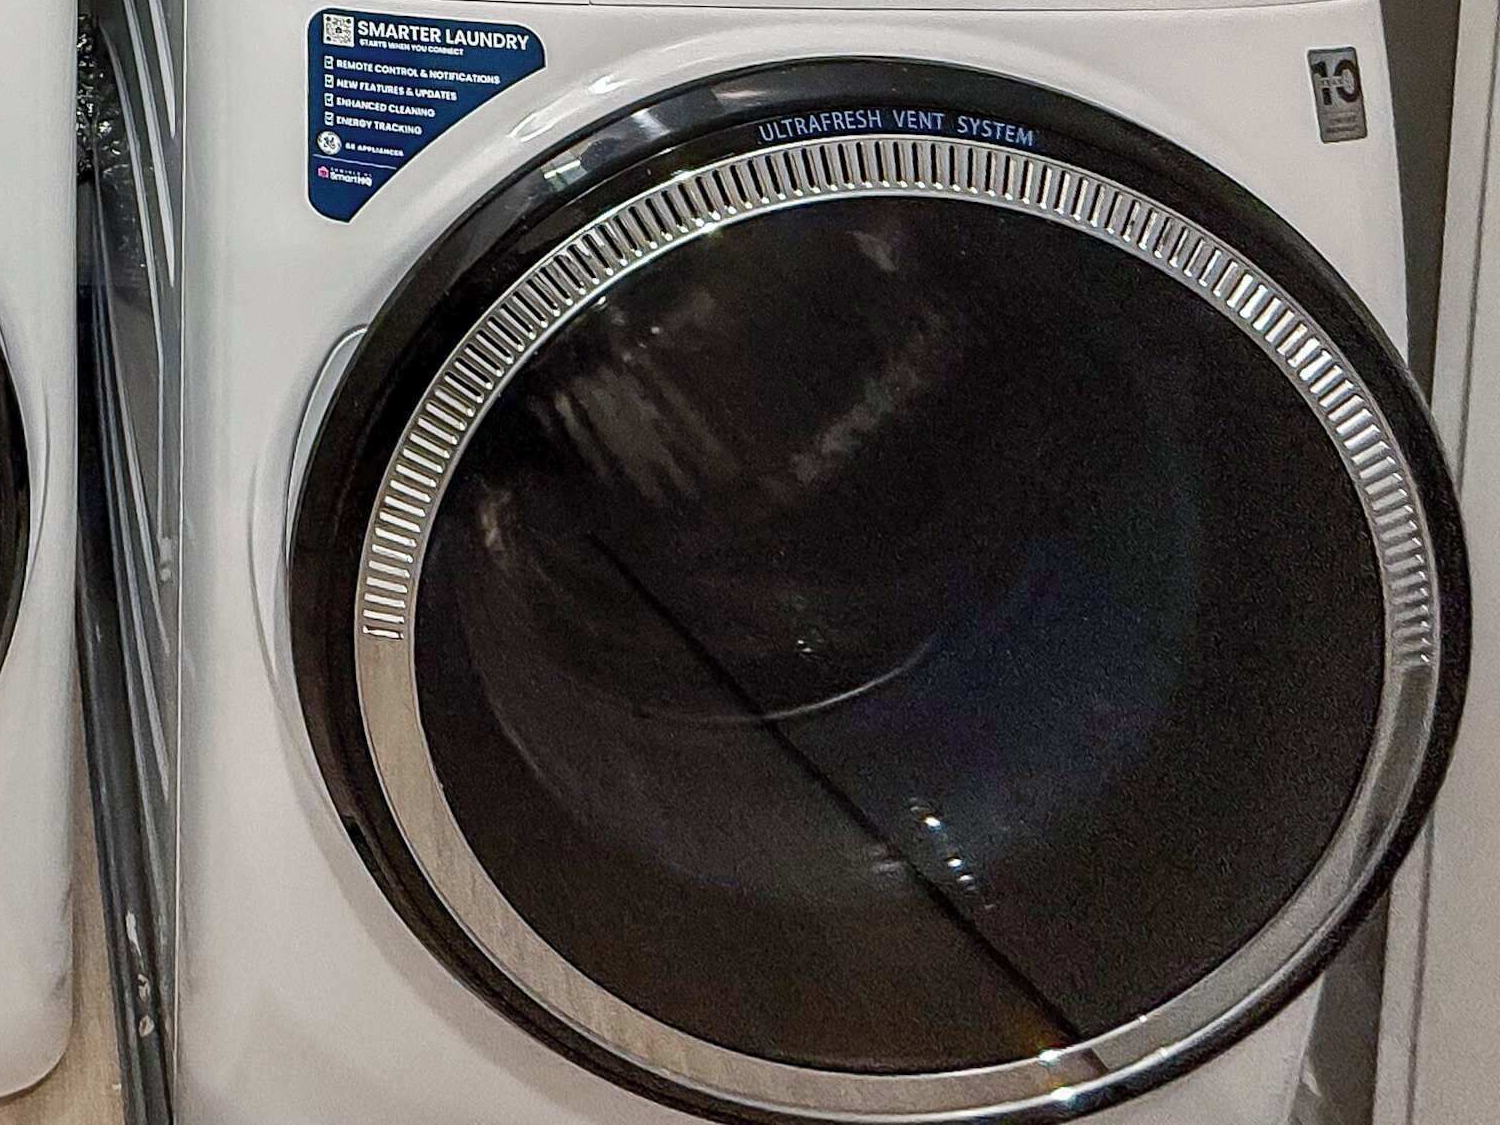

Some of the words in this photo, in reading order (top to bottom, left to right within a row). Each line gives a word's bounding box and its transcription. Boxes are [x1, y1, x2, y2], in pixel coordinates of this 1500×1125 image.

[358, 21, 441, 43] SMARTER
[445, 26, 529, 50] LAUNDRY
[359, 38, 388, 48] STARTS
[388, 42, 410, 51] WHEN
[411, 43, 427, 52] YOU
[336, 59, 373, 73] REMOTE
[375, 63, 418, 78] CONTROL
[421, 69, 428, 78] &
[429, 69, 500, 85] NOTIFICATIONS
[1311, 59, 1361, 106] 10
[336, 79, 358, 90] NEW
[360, 81, 404, 96] FEATURES
[406, 86, 414, 96] &
[415, 87, 457, 101] UPDATES
[336, 97, 387, 113] ENHANCED
[388, 103, 435, 118] CLEANING
[336, 116, 373, 129] ENERGY
[374, 121, 422, 135] TRACKING
[759, 110, 882, 142] ULTRAFRESH
[892, 109, 946, 130] VENT
[957, 115, 1034, 146] SYSTEM
